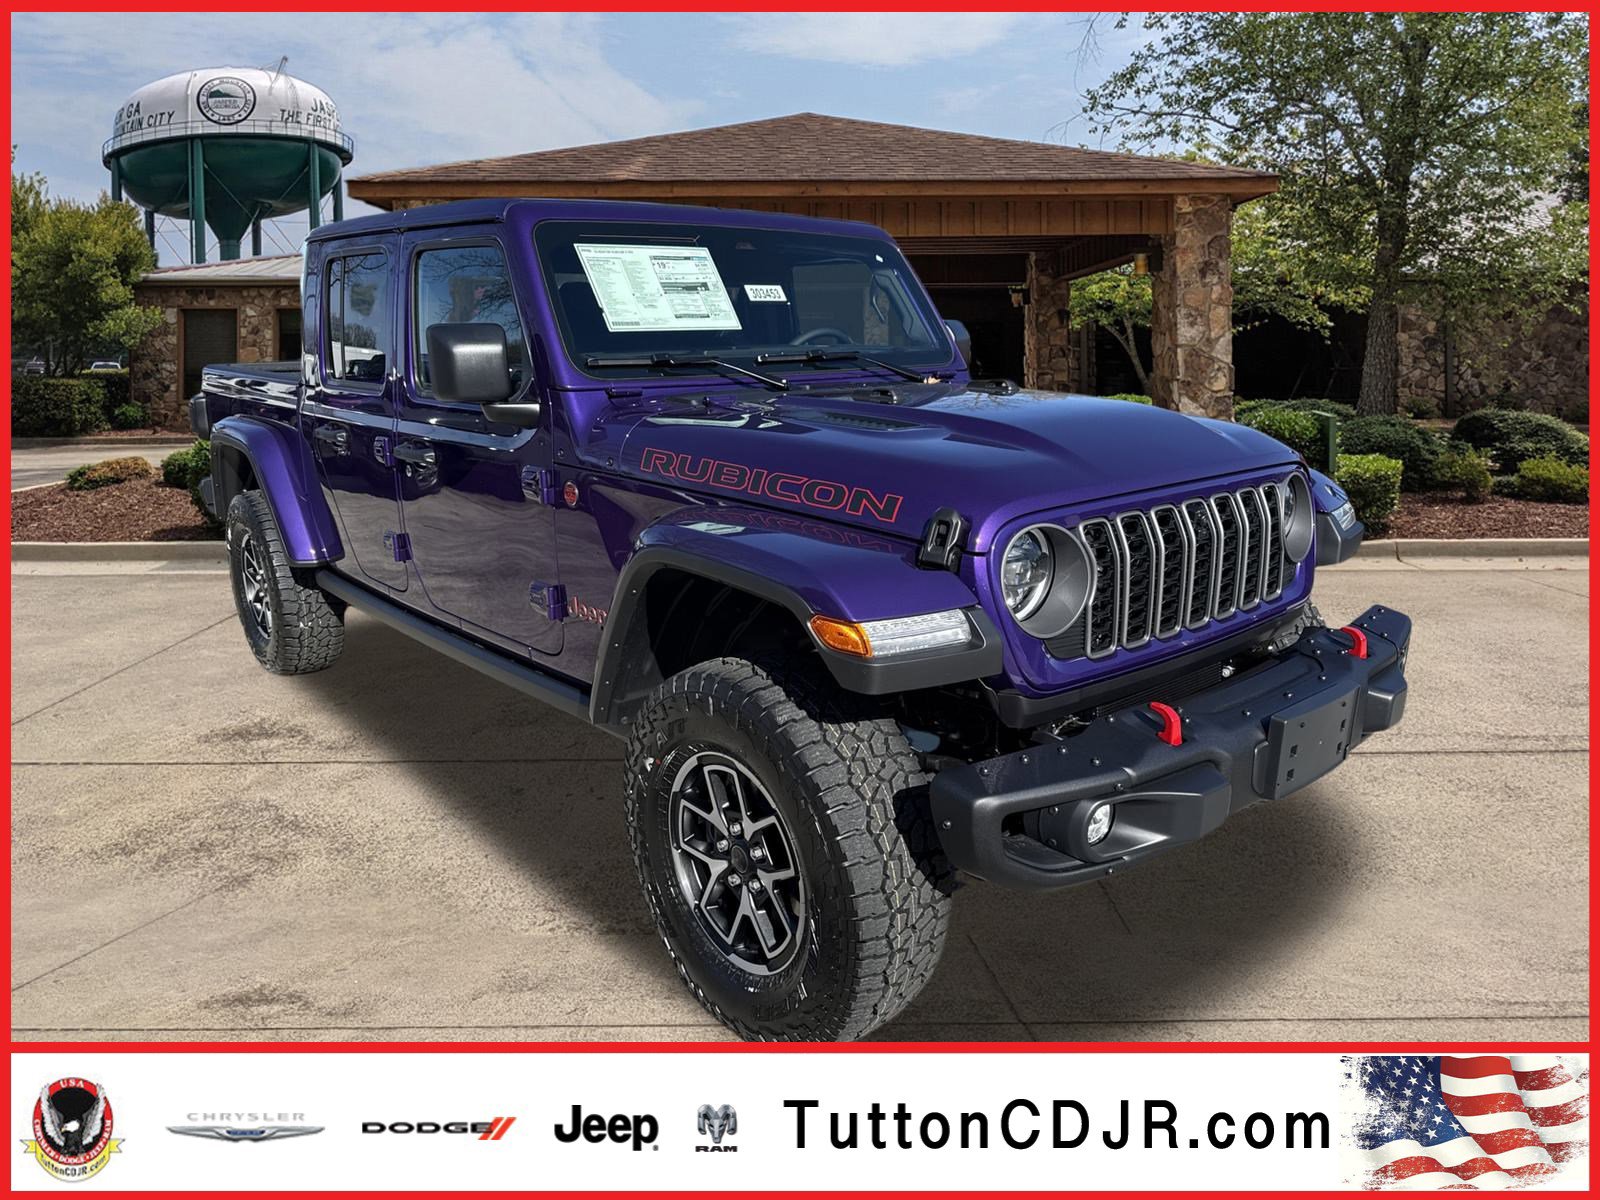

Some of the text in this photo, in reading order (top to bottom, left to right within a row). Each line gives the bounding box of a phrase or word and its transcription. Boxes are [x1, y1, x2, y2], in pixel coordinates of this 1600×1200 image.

[126, 101, 141, 119] GA
[147, 110, 175, 127] CITY
[280, 109, 302, 124] THE
[750, 287, 781, 299] 303453
[640, 447, 903, 523] RUBICON
